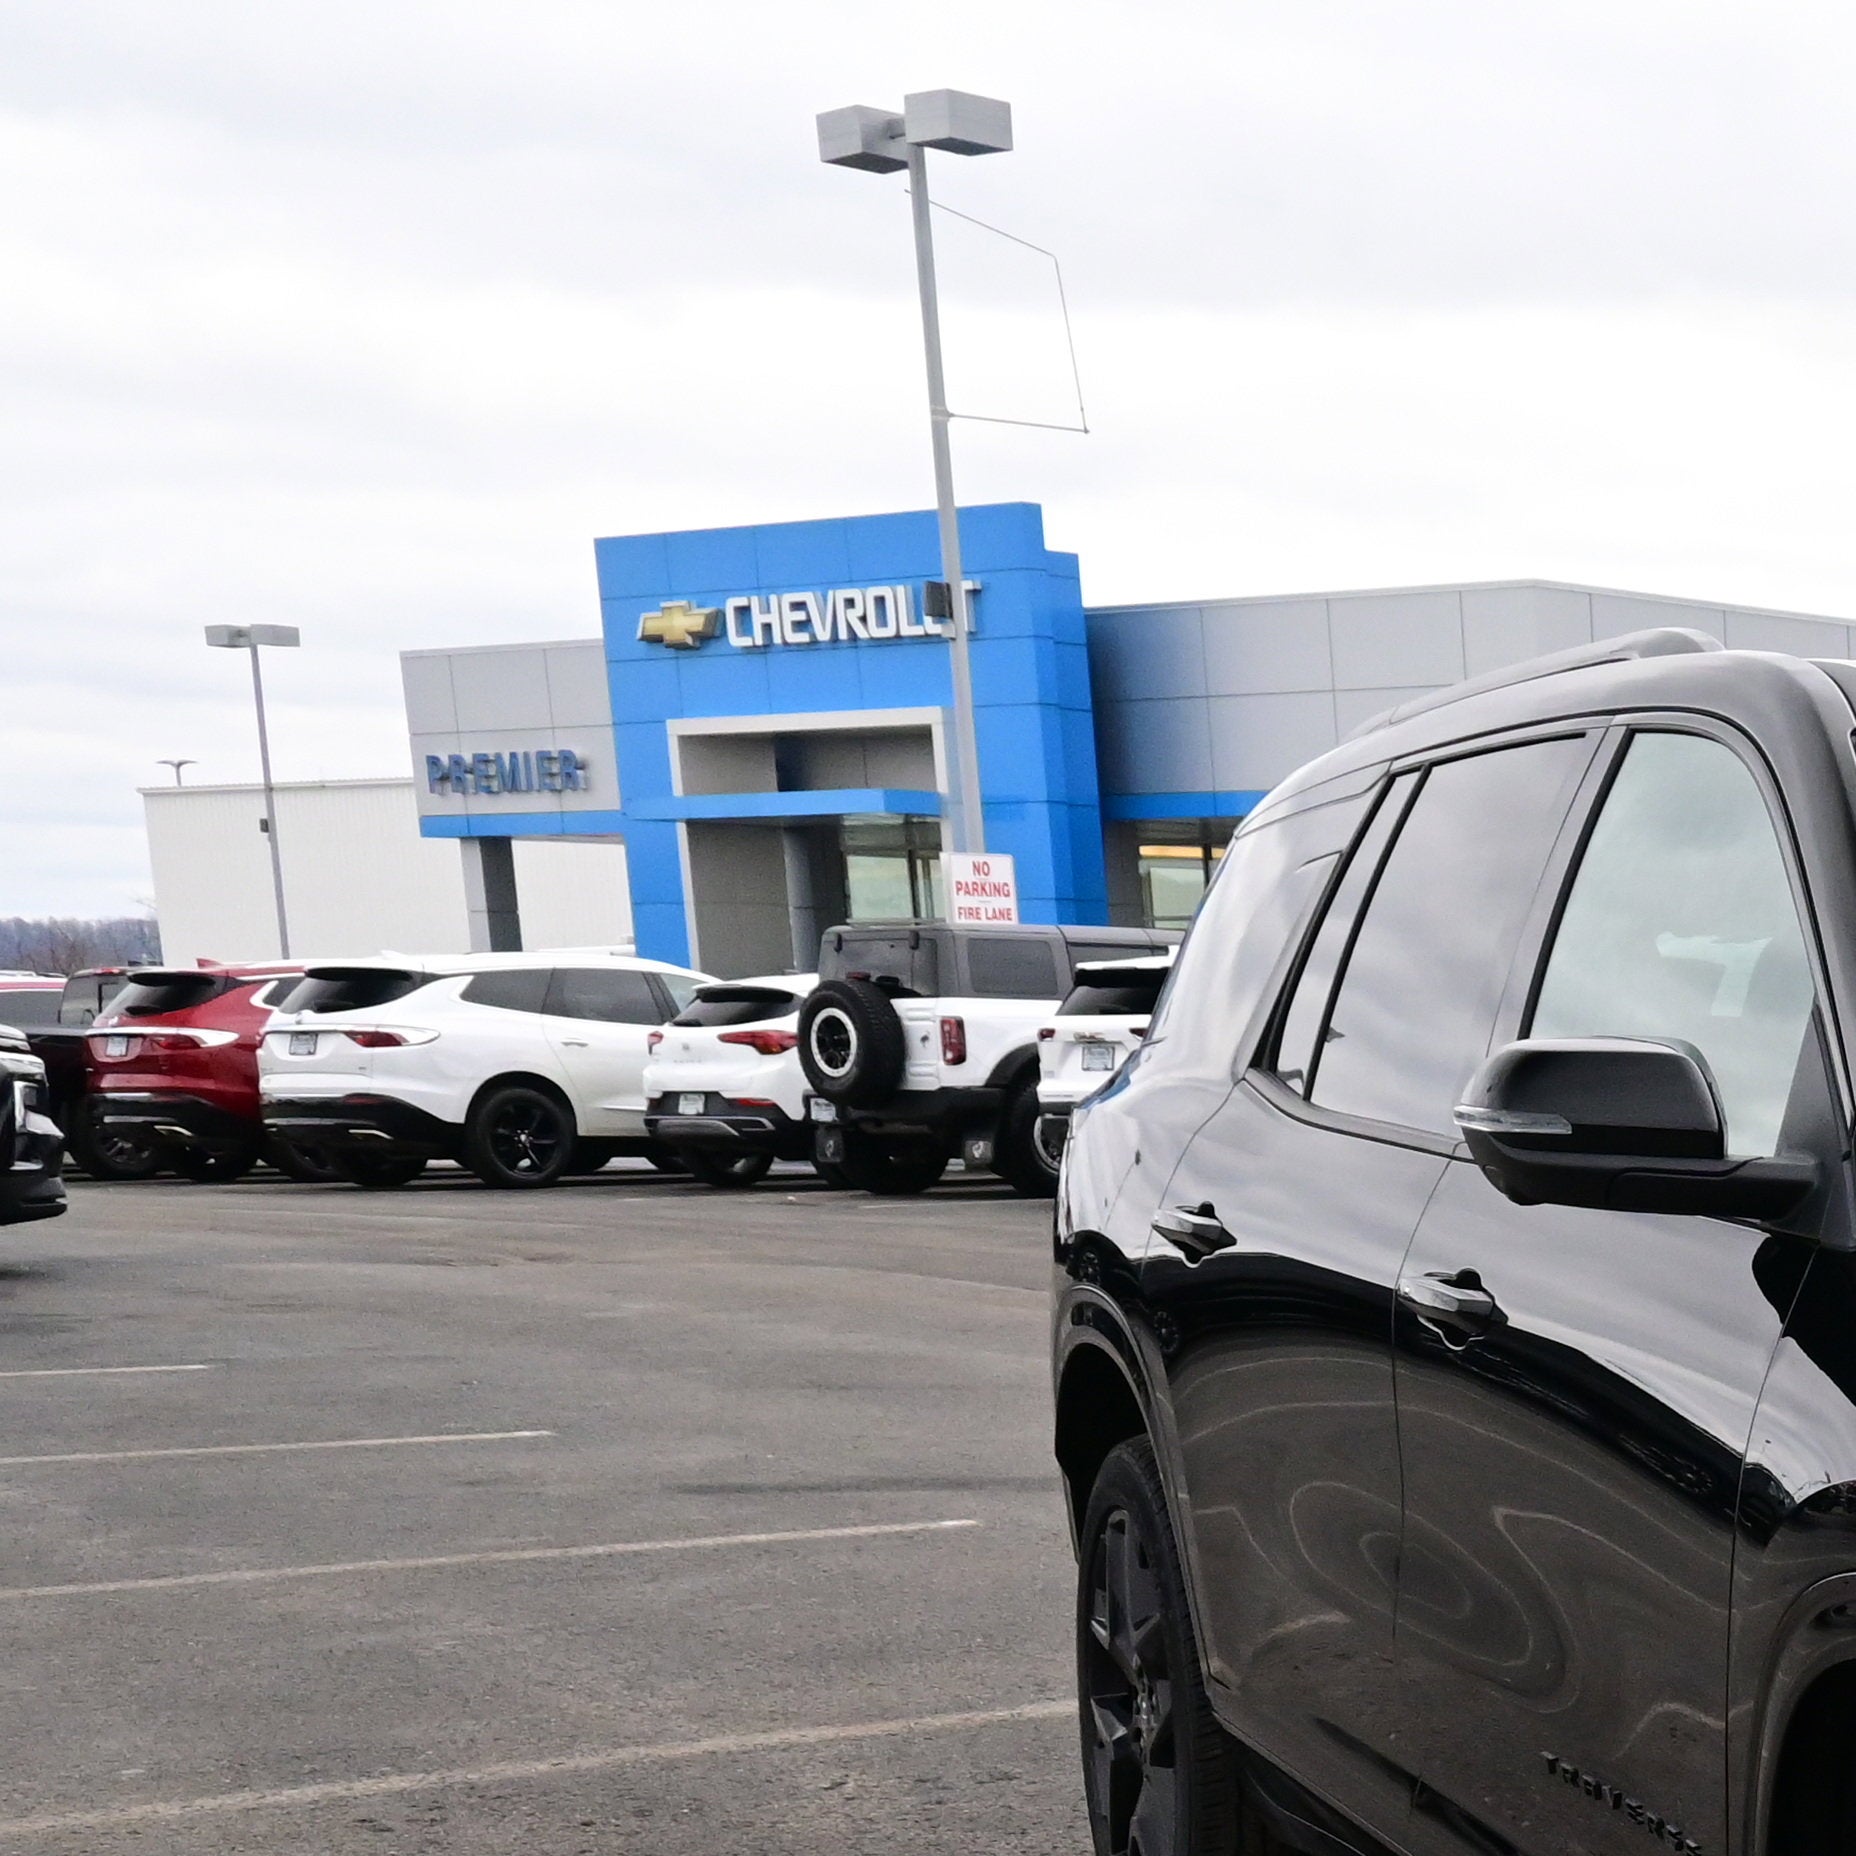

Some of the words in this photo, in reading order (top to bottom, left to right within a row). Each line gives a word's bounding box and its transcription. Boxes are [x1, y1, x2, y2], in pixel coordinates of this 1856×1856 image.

[425, 749, 585, 795] PREMIER
[972, 860, 991, 877] NO
[955, 880, 1011, 898] PARKING
[957, 906, 982, 921] FIRE
[985, 907, 1013, 921] LANE
